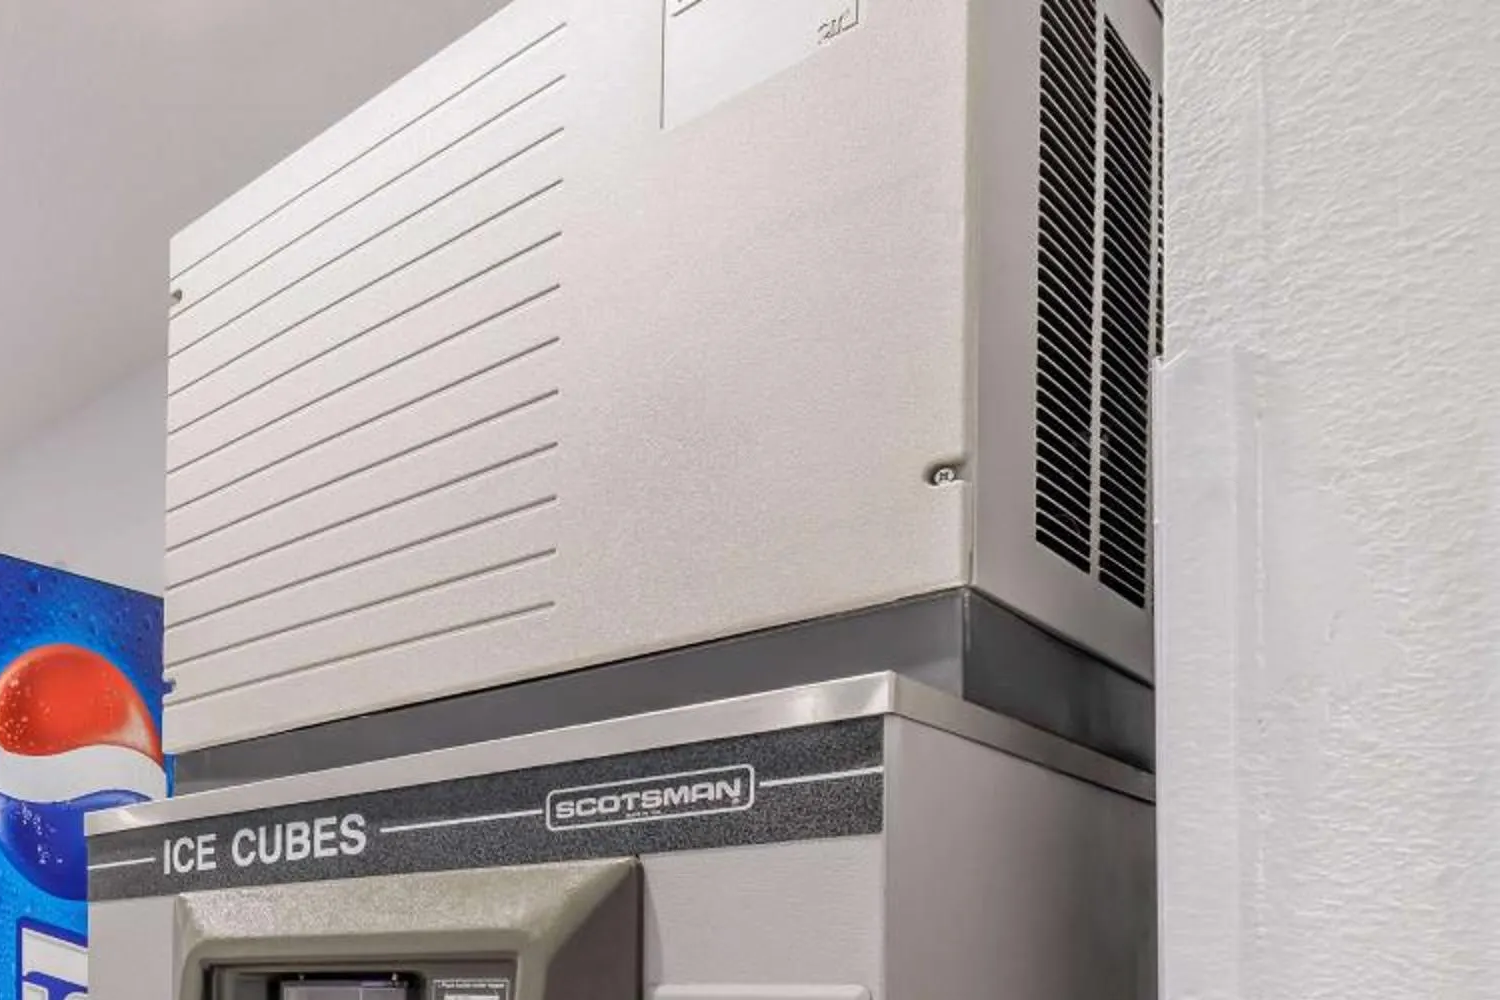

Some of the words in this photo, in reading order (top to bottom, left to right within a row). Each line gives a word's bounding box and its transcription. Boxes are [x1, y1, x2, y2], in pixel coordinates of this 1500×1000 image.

[555, 777, 742, 819] SCOTSMAN
[163, 832, 218, 875] ICE
[231, 813, 368, 868] CUBES
